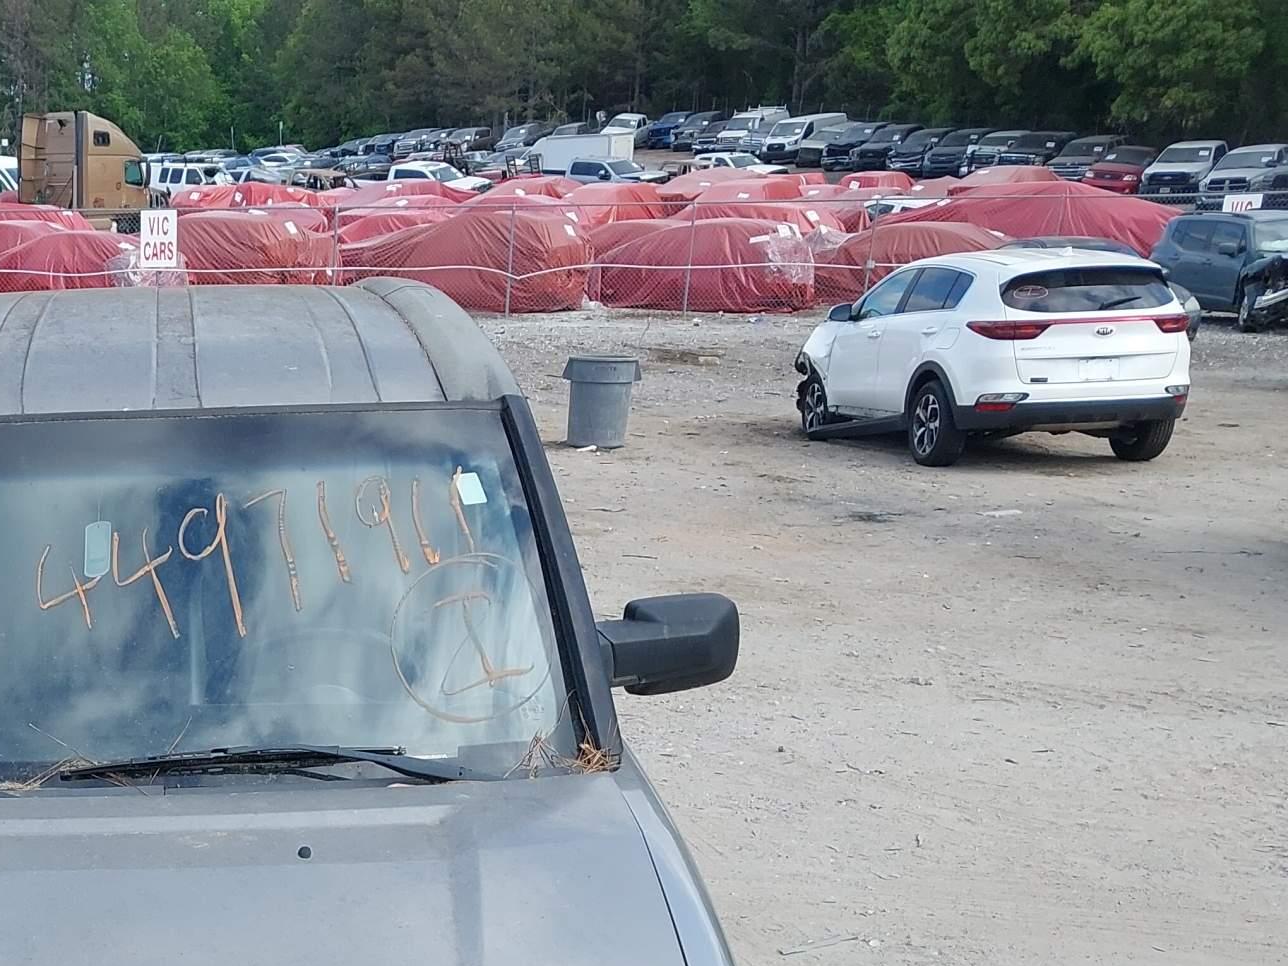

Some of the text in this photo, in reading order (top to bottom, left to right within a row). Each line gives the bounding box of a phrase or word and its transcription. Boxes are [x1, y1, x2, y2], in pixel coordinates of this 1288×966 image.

[148, 216, 169, 236] VIC
[143, 241, 174, 261] CARS
[35, 465, 476, 639] 44971911
